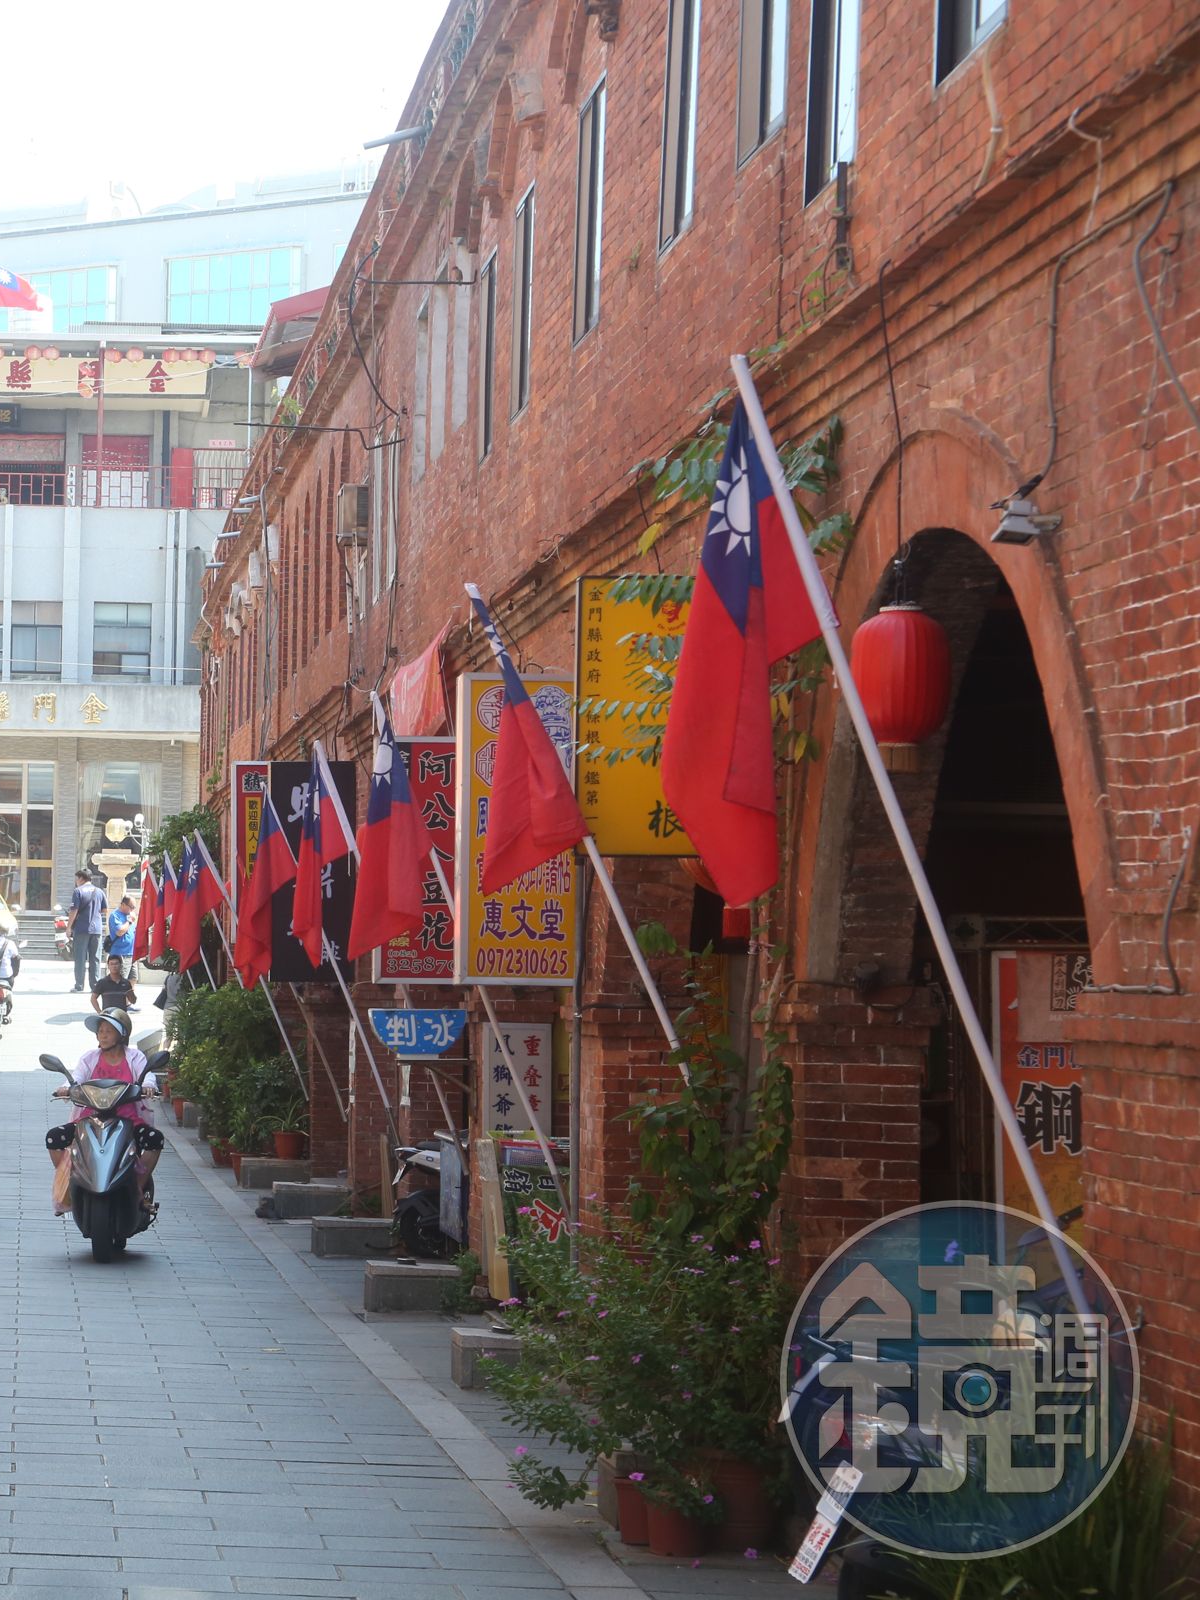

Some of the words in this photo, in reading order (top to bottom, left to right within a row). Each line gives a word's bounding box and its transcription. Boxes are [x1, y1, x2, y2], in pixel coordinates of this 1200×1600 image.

[480, 898, 566, 942] 惠文堂
[476, 947, 569, 976] 0972310625
